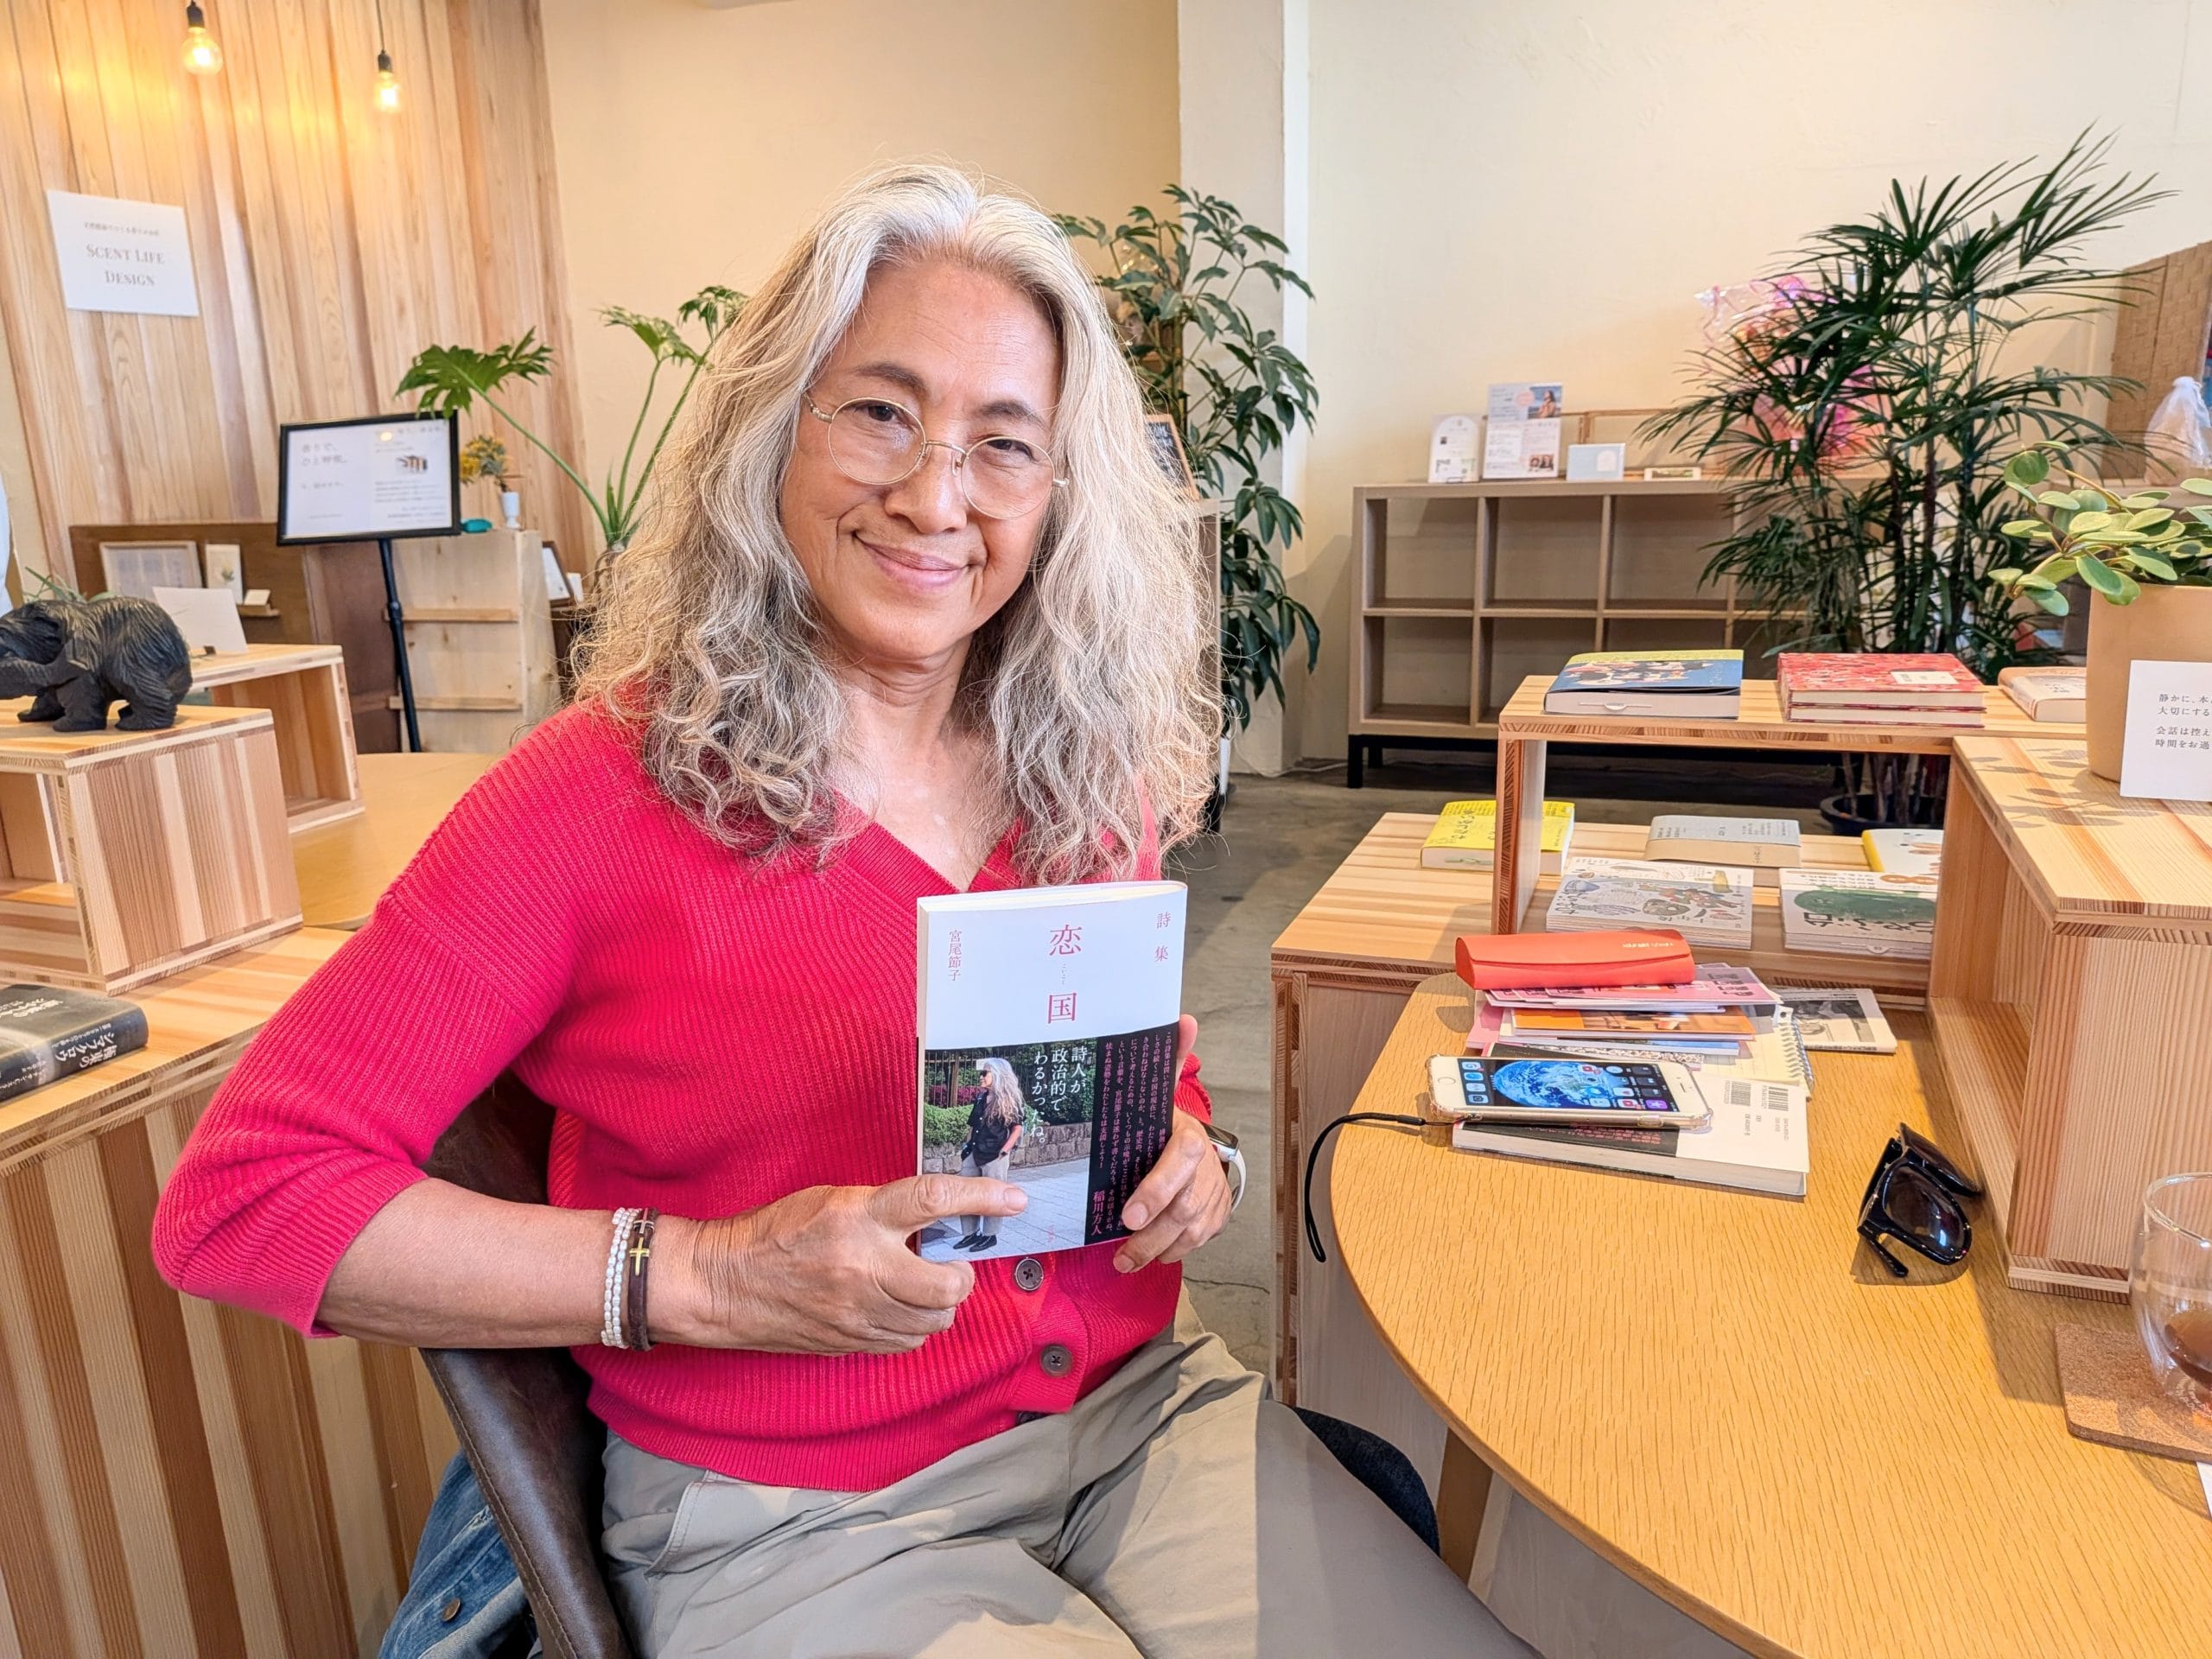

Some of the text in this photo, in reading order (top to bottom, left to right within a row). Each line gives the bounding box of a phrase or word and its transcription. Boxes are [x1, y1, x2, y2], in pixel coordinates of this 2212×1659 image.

[86, 243, 166, 265] SCENT LIFE
[104, 270, 156, 287] DESIGN
[2157, 706, 2210, 717] 大切にする
[2158, 693, 2212, 704] 静かに、本
[2155, 739, 2209, 750] 時間をお過
[2156, 726, 2210, 737] 会話は控え
[1154, 912, 1172, 963] 詩集
[947, 929, 963, 982] 宮尾節子
[55, 1033, 116, 1062] シマフクロウ
[79, 1045, 118, 1070] 極東の
[1050, 1047, 1069, 1112] 政治的で
[1070, 1045, 1088, 1094] 詩人が
[1029, 1051, 1048, 1144] わるかったね。
[1090, 1189, 1106, 1236] 稲川方人
